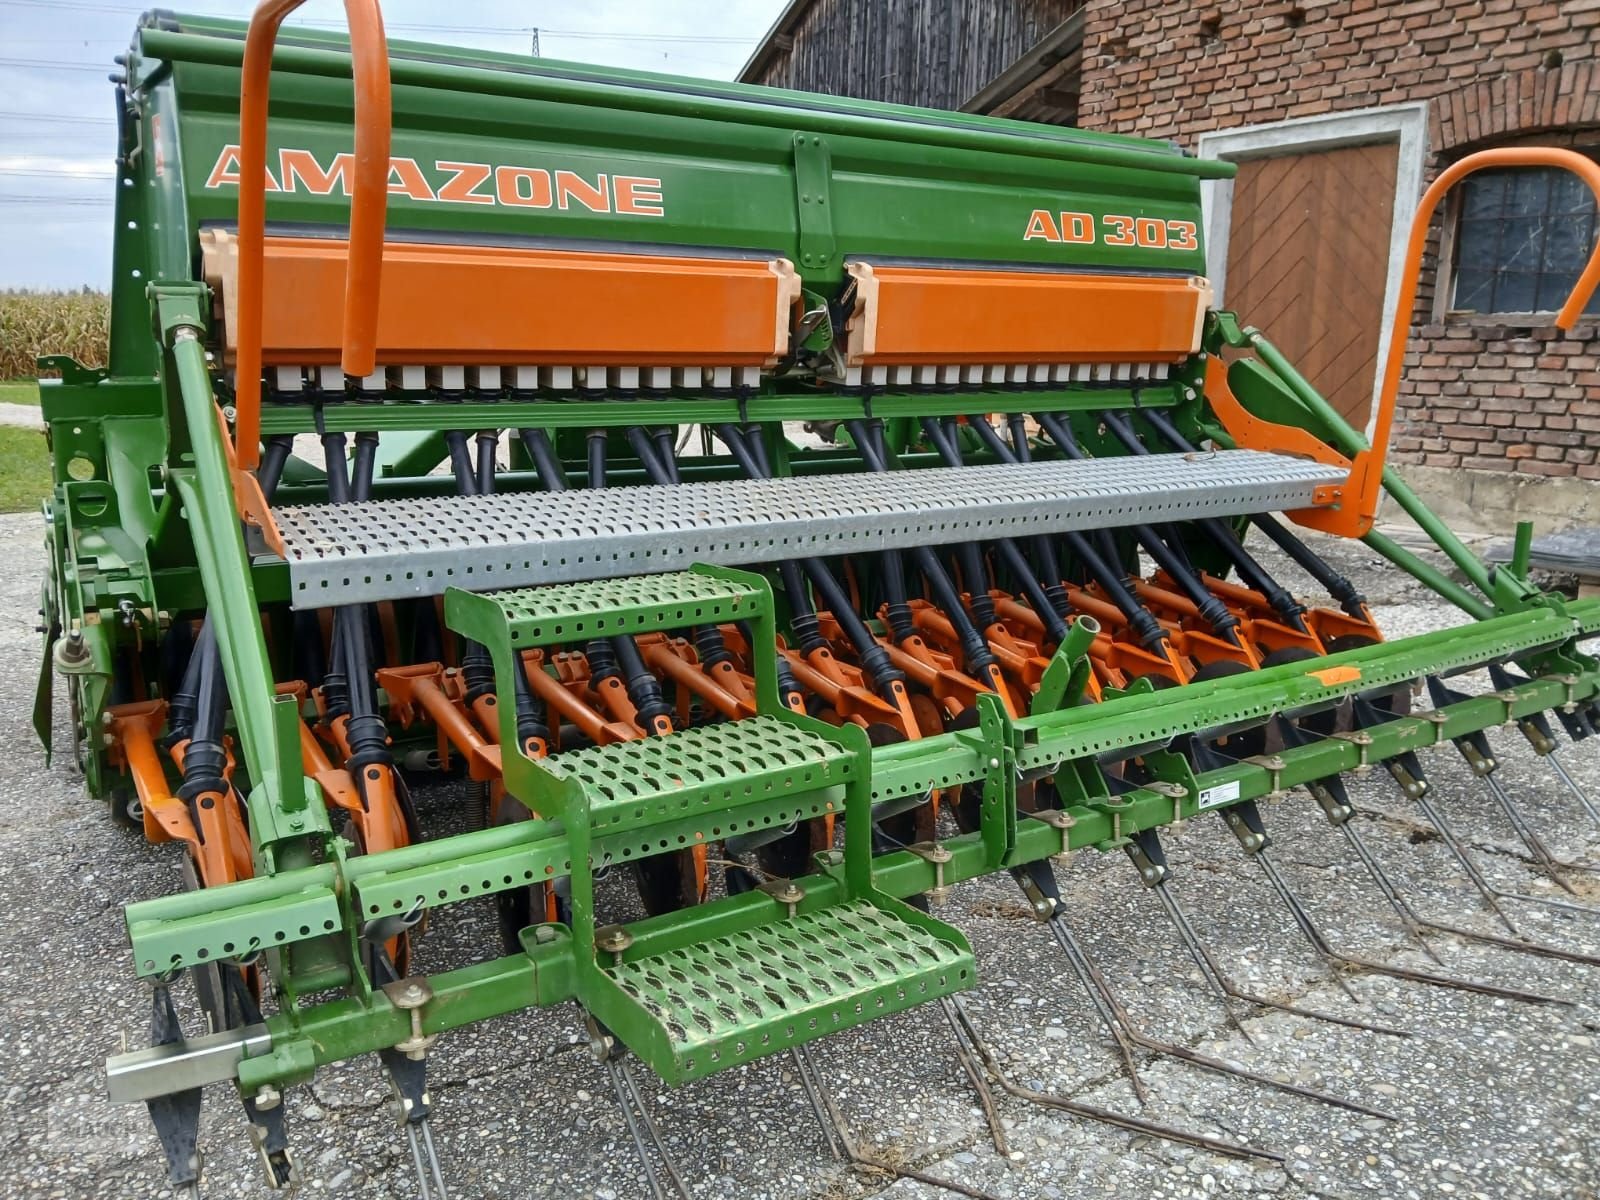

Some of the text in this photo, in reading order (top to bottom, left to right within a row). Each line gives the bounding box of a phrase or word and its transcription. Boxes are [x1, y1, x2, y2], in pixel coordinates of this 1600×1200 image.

[205, 144, 664, 216] AMAZONE
[1023, 209, 1198, 251] AD 303
